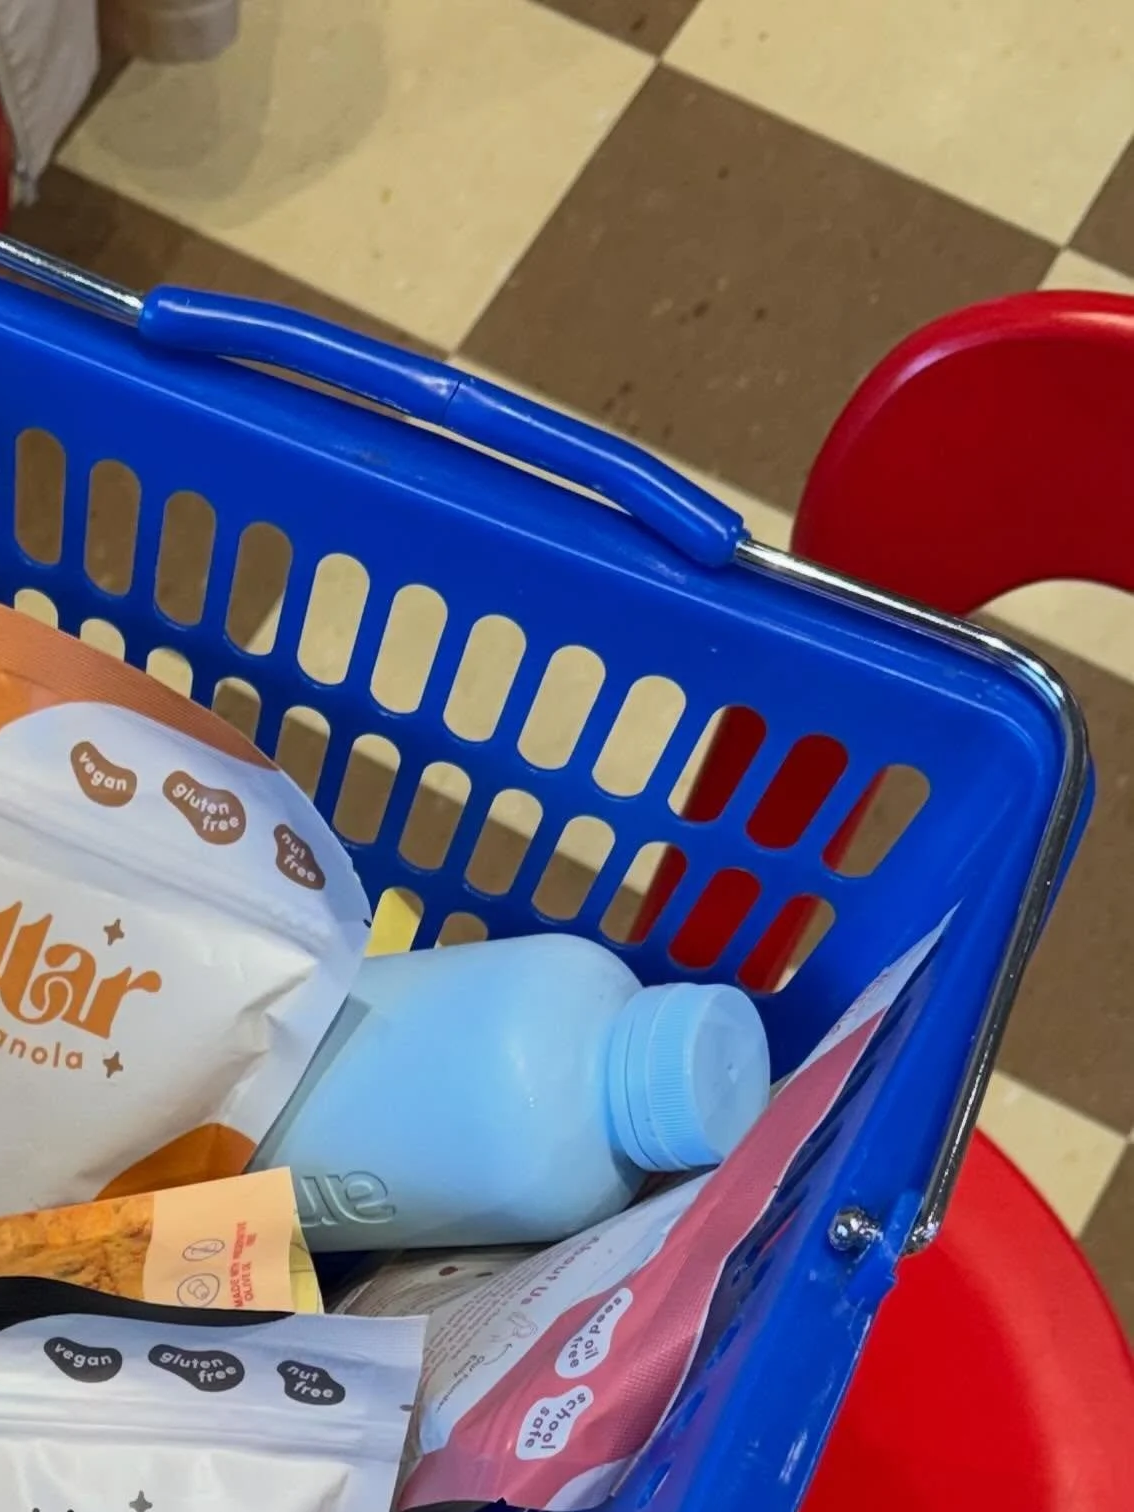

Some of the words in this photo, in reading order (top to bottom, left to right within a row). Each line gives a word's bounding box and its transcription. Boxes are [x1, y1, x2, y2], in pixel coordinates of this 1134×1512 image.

[78, 750, 128, 793] vegan
[172, 781, 230, 816] gluten
[202, 813, 241, 833] free
[281, 831, 306, 860] nut
[284, 853, 317, 883] free
[589, 1296, 622, 1335] seed
[52, 1341, 113, 1368] vegan
[159, 1349, 224, 1374] gluten
[569, 1336, 584, 1368] free
[584, 1340, 599, 1360] oil
[196, 1364, 237, 1383] free
[286, 1364, 321, 1384] nut
[292, 1379, 336, 1399] free
[525, 1406, 550, 1449] safe
[541, 1392, 586, 1449] school
